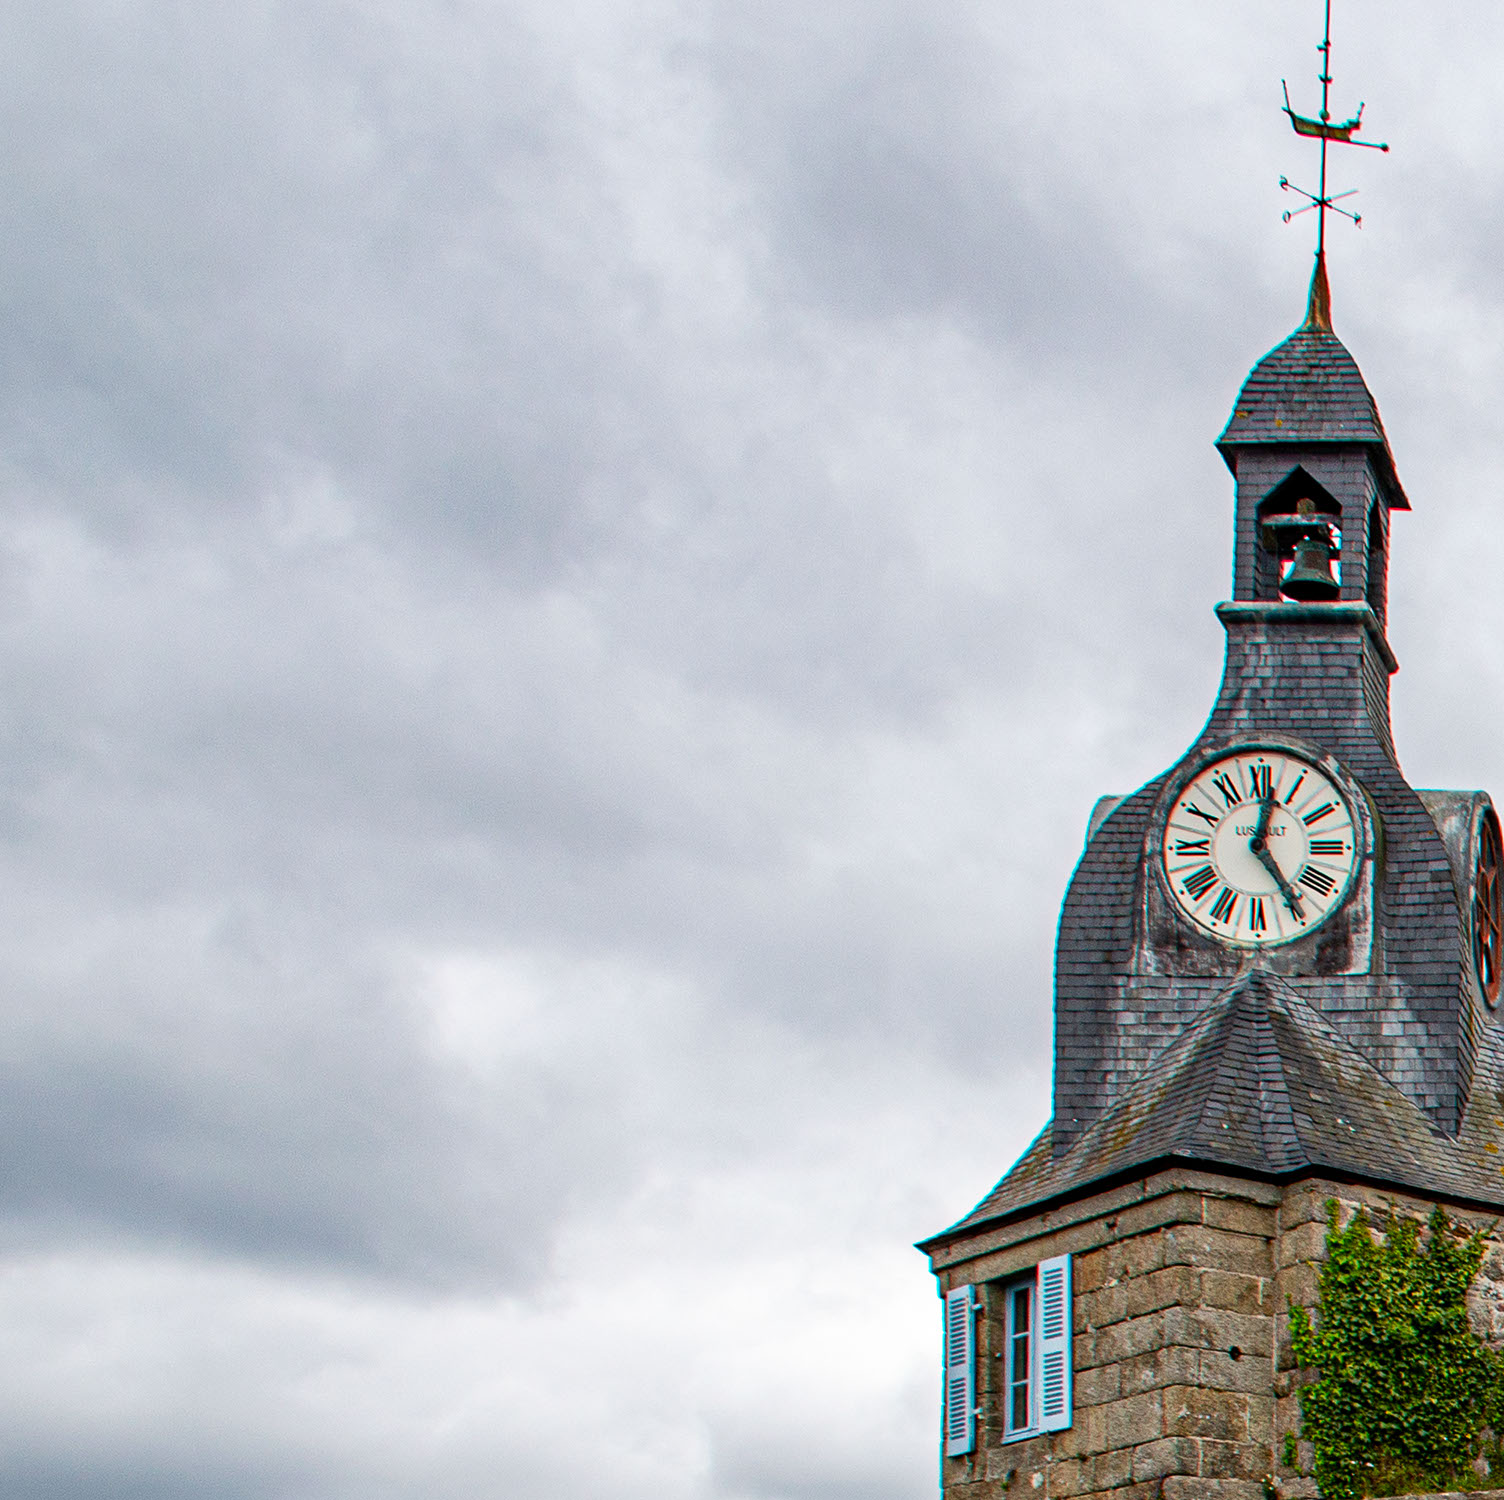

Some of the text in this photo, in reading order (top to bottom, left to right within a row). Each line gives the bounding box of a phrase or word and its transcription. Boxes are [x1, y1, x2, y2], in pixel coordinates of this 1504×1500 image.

[1212, 772, 1243, 808] XI
[1249, 764, 1272, 799] XII
[1283, 774, 1305, 806] I
[1185, 801, 1220, 828] X
[1235, 825, 1287, 837] LUSULT
[1302, 802, 1336, 827] II
[1175, 838, 1210, 856] IX
[1310, 840, 1344, 855] III
[1181, 864, 1219, 902] VIII
[1298, 864, 1337, 898] IIII
[1209, 886, 1239, 925] VII
[1249, 897, 1267, 931] VI
